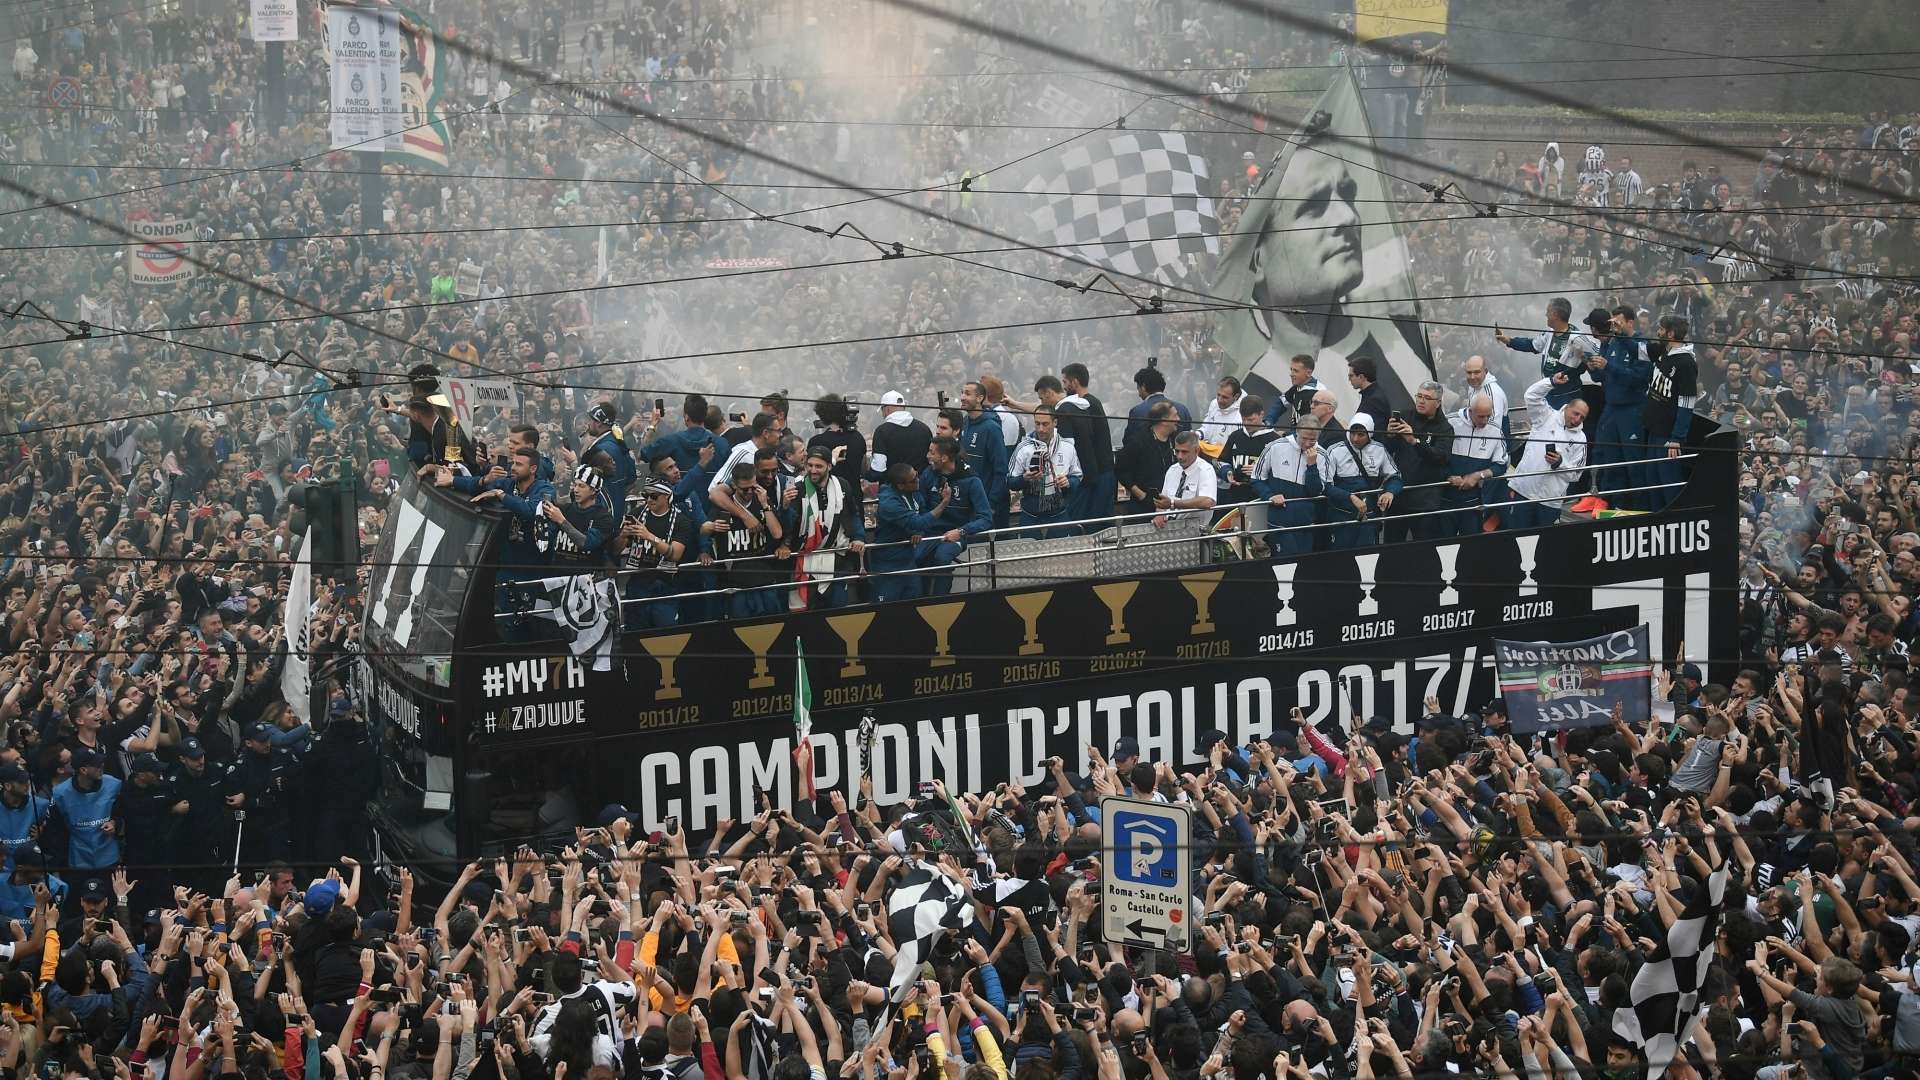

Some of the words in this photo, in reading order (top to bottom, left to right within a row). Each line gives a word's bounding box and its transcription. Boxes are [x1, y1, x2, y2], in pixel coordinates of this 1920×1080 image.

[335, 50, 375, 58] VALENTINO
[343, 41, 367, 49] PARCO
[336, 106, 379, 115] VALENTINO
[345, 98, 369, 106] PARCO
[133, 222, 193, 236] LONDRA
[134, 271, 192, 282] BIANCONERA
[476, 386, 510, 401] CONTINUA
[1592, 519, 1710, 564] JUVENTUS
[1423, 610, 1476, 632] 2016/17
[1503, 601, 1554, 622] 2017/18
[1259, 630, 1314, 652] 2014/15
[1341, 620, 1395, 642] 2015/16
[1090, 650, 1147, 673] 2016/17
[1176, 640, 1231, 661] 2017/18
[482, 656, 585, 698] #MY7H
[1003, 661, 1061, 683] 2015/16
[823, 683, 884, 706] 2013/14
[914, 672, 973, 695] 2014/15
[639, 705, 700, 729] 2011/12
[732, 694, 793, 718] 2012/13
[640, 714, 982, 836] CAMPIONI
[1008, 677, 1273, 790] D'ITALIA
[1298, 645, 1504, 738] 2017/1
[1109, 884, 1133, 897] Roma
[1140, 889, 1156, 901] San
[1158, 892, 1183, 905] Carlo
[1127, 901, 1164, 916] Castello
